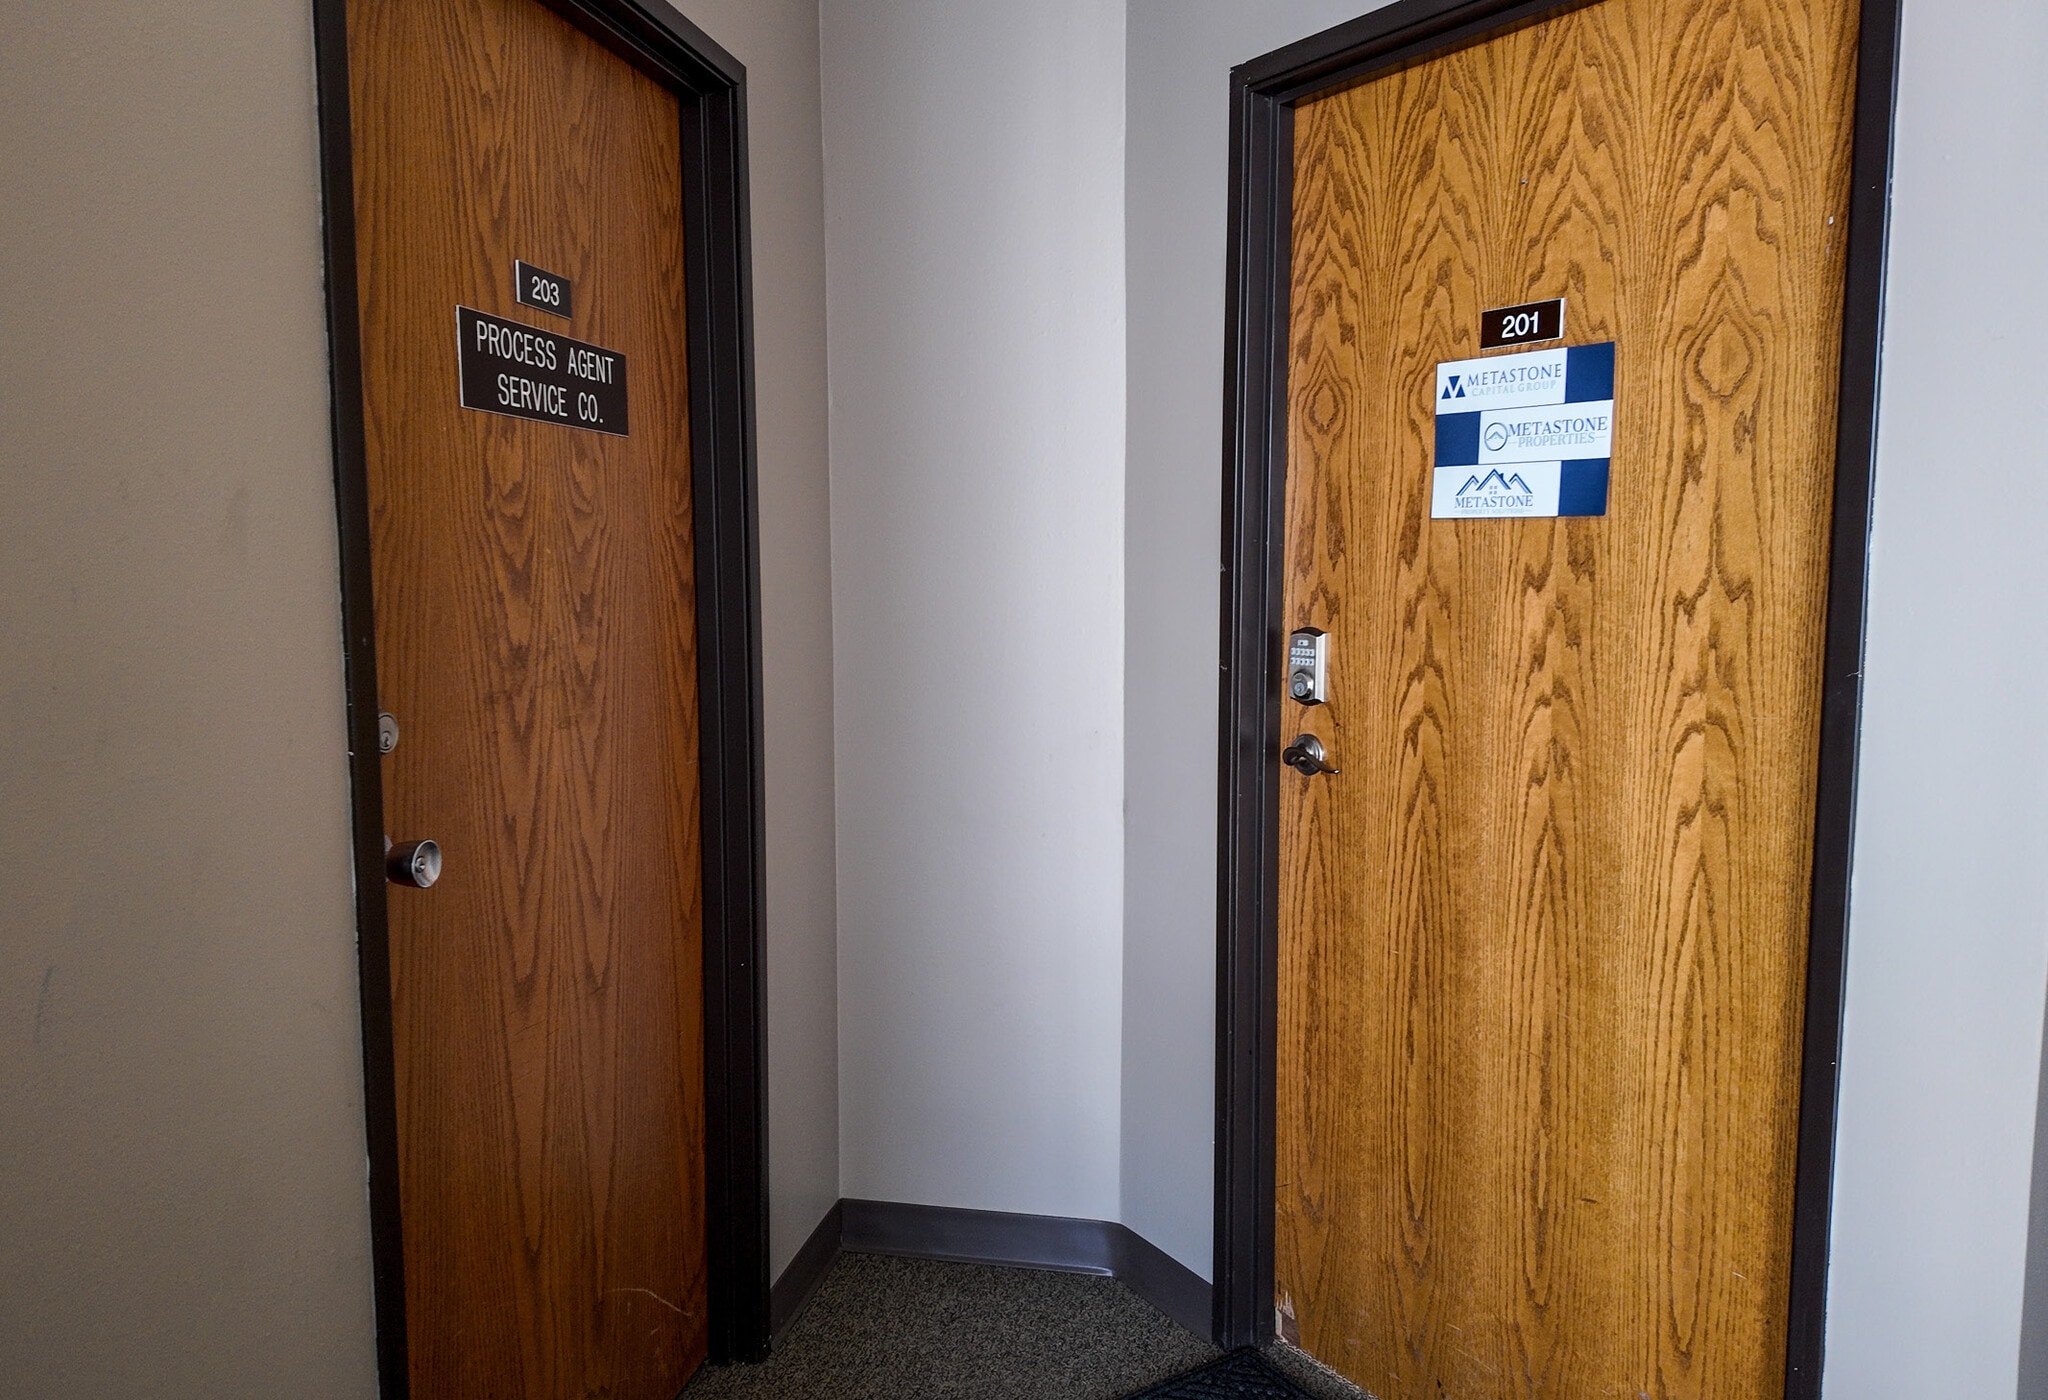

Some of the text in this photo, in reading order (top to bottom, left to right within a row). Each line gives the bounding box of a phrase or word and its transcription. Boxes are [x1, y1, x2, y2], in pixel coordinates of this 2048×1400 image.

[531, 275, 560, 306] 203
[1501, 311, 1540, 339] 201
[476, 320, 614, 384] PROCESS AGENT
[1467, 363, 1562, 388] METASTONE
[497, 373, 604, 423] SERVICE CO.
[1471, 380, 1557, 398] CAPITAL GROUP
[1508, 416, 1608, 437] METASTONE
[1518, 431, 1595, 448] PROPERTIES
[1454, 495, 1534, 509] METASTONE
